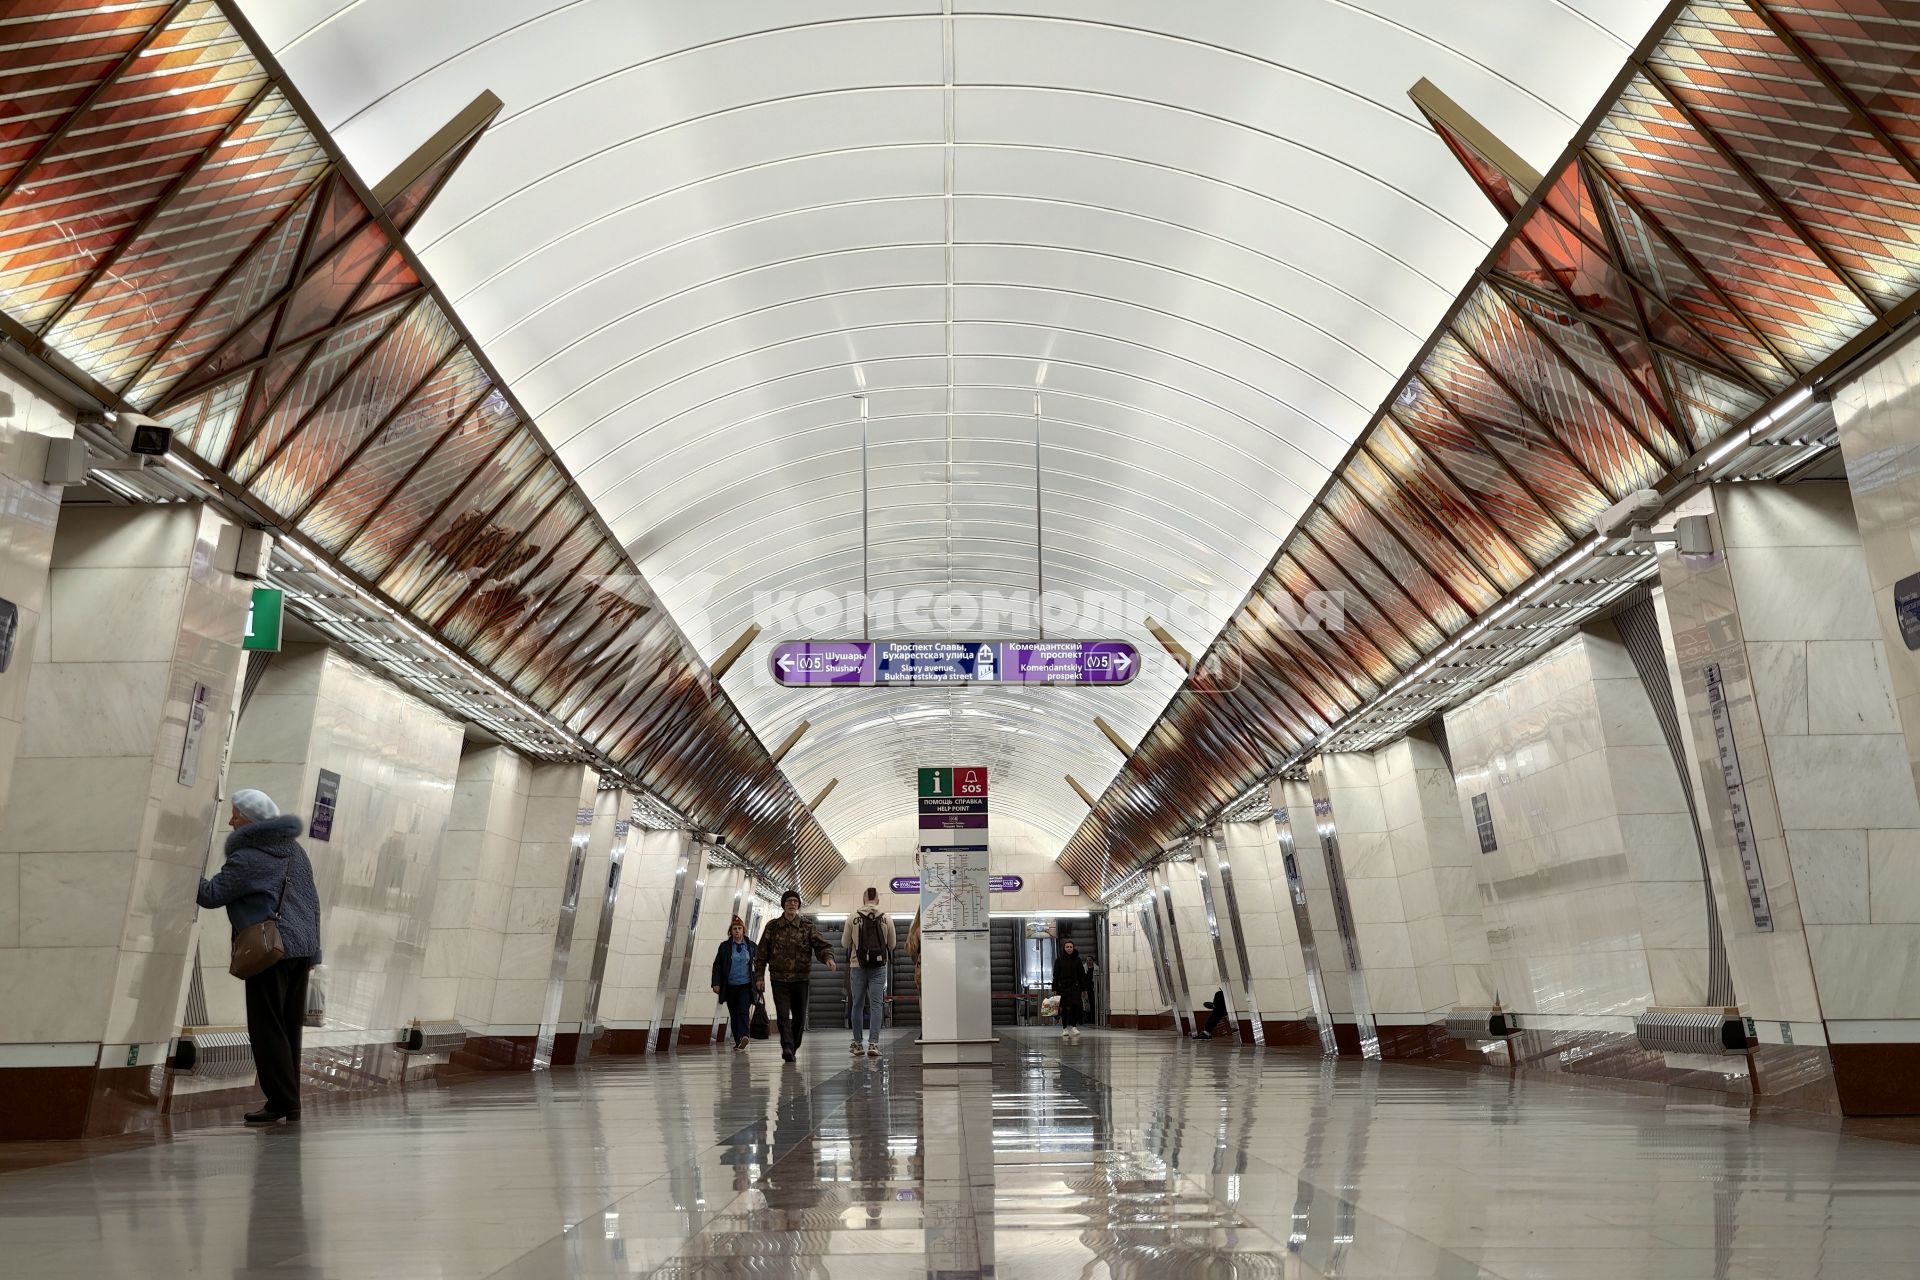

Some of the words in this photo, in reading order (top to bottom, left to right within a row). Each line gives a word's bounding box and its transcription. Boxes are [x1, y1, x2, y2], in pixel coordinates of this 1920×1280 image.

[890, 643, 932, 652] Проспект
[934, 643, 967, 652] Славы,
[1009, 642, 1083, 651] Комендантский
[825, 652, 867, 661] Шушары
[882, 652, 945, 661] Бухарестская
[946, 652, 974, 661] улица
[1040, 652, 1083, 660] проспект
[825, 665, 862, 673] Shushary
[901, 664, 923, 673] Slavy
[924, 665, 956, 673] avenue,
[1020, 664, 1083, 673] Komendantskiy
[884, 673, 948, 681] Bukharestskaya
[949, 673, 973, 681] street
[1047, 672, 1083, 680] prospekt
[961, 784, 982, 793] SOS
